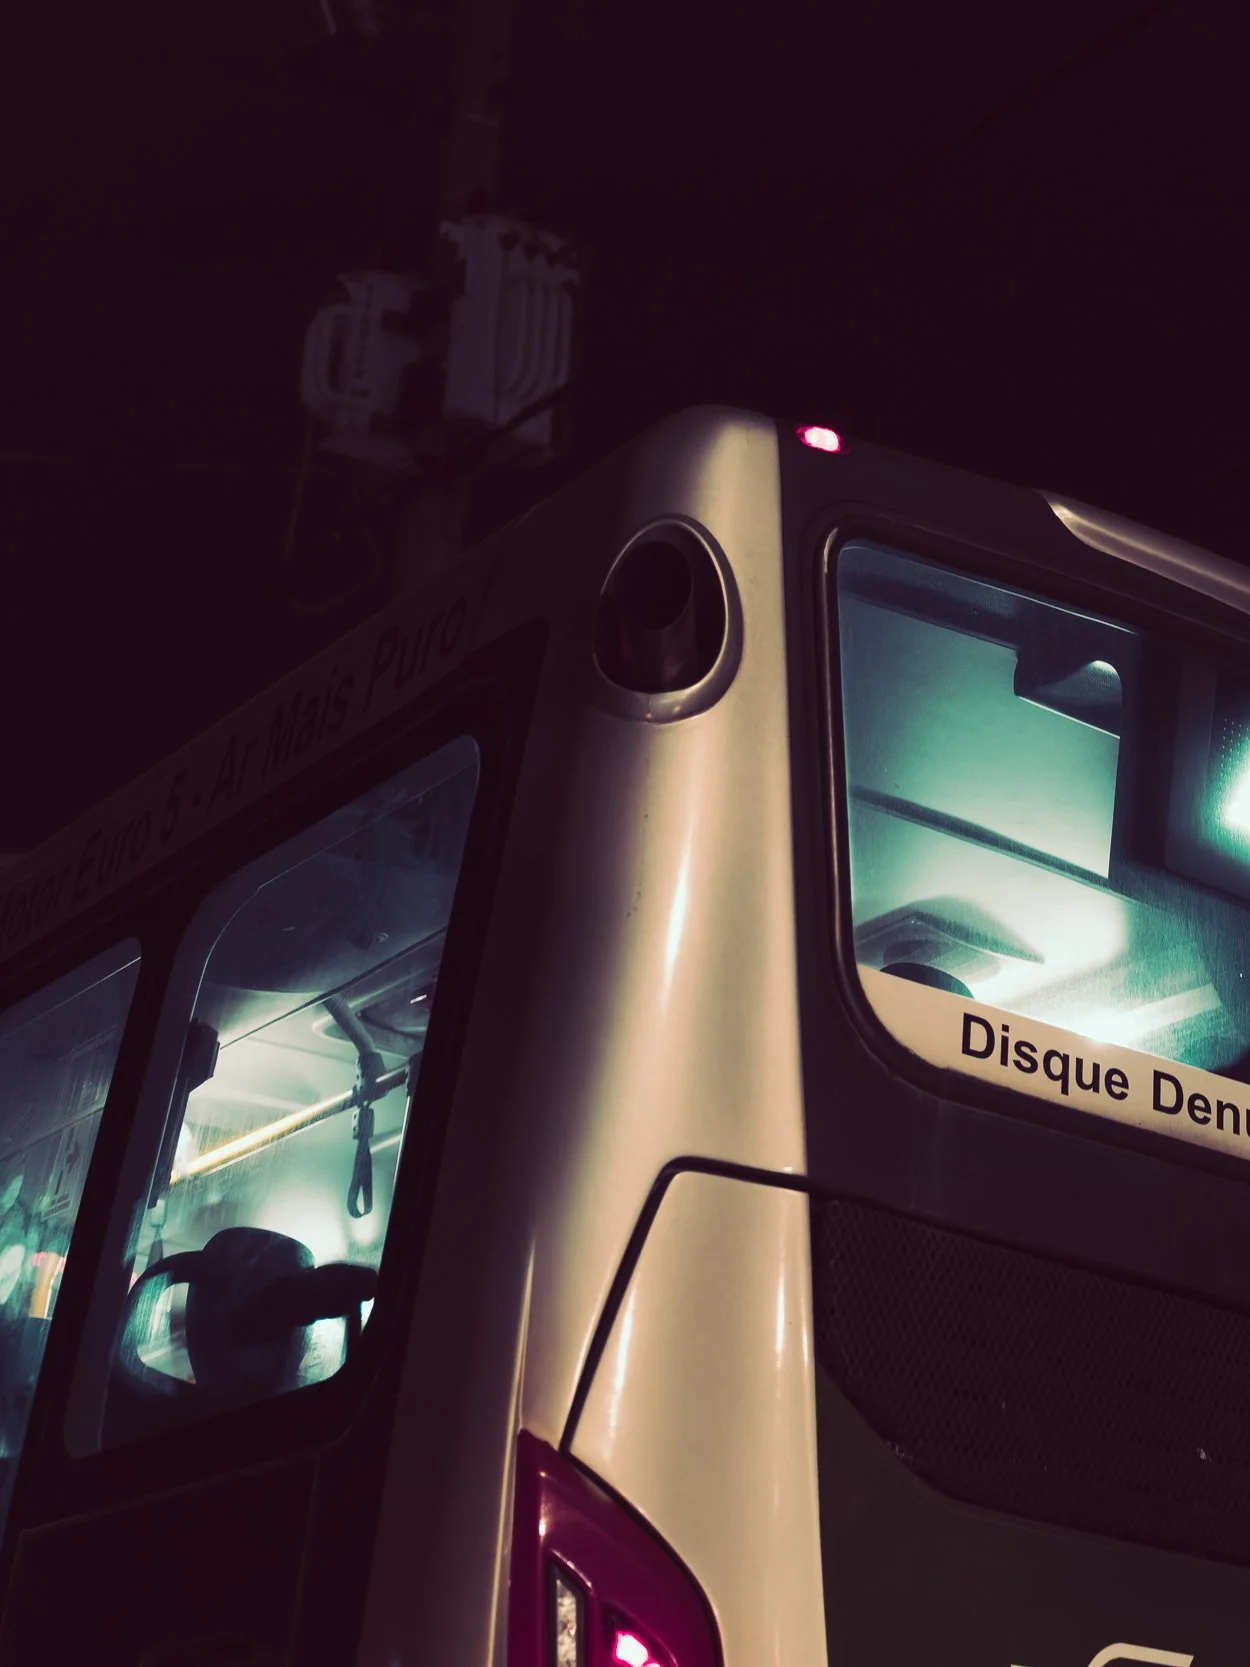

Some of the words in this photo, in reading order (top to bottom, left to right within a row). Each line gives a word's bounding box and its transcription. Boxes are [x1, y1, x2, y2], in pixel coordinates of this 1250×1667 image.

[71, 809, 151, 906] Euro
[160, 769, 187, 843] 5
[206, 734, 259, 814] Ar
[262, 664, 355, 782] Mais
[364, 596, 468, 712] Puro
[961, 1012, 1130, 1101] Disque
